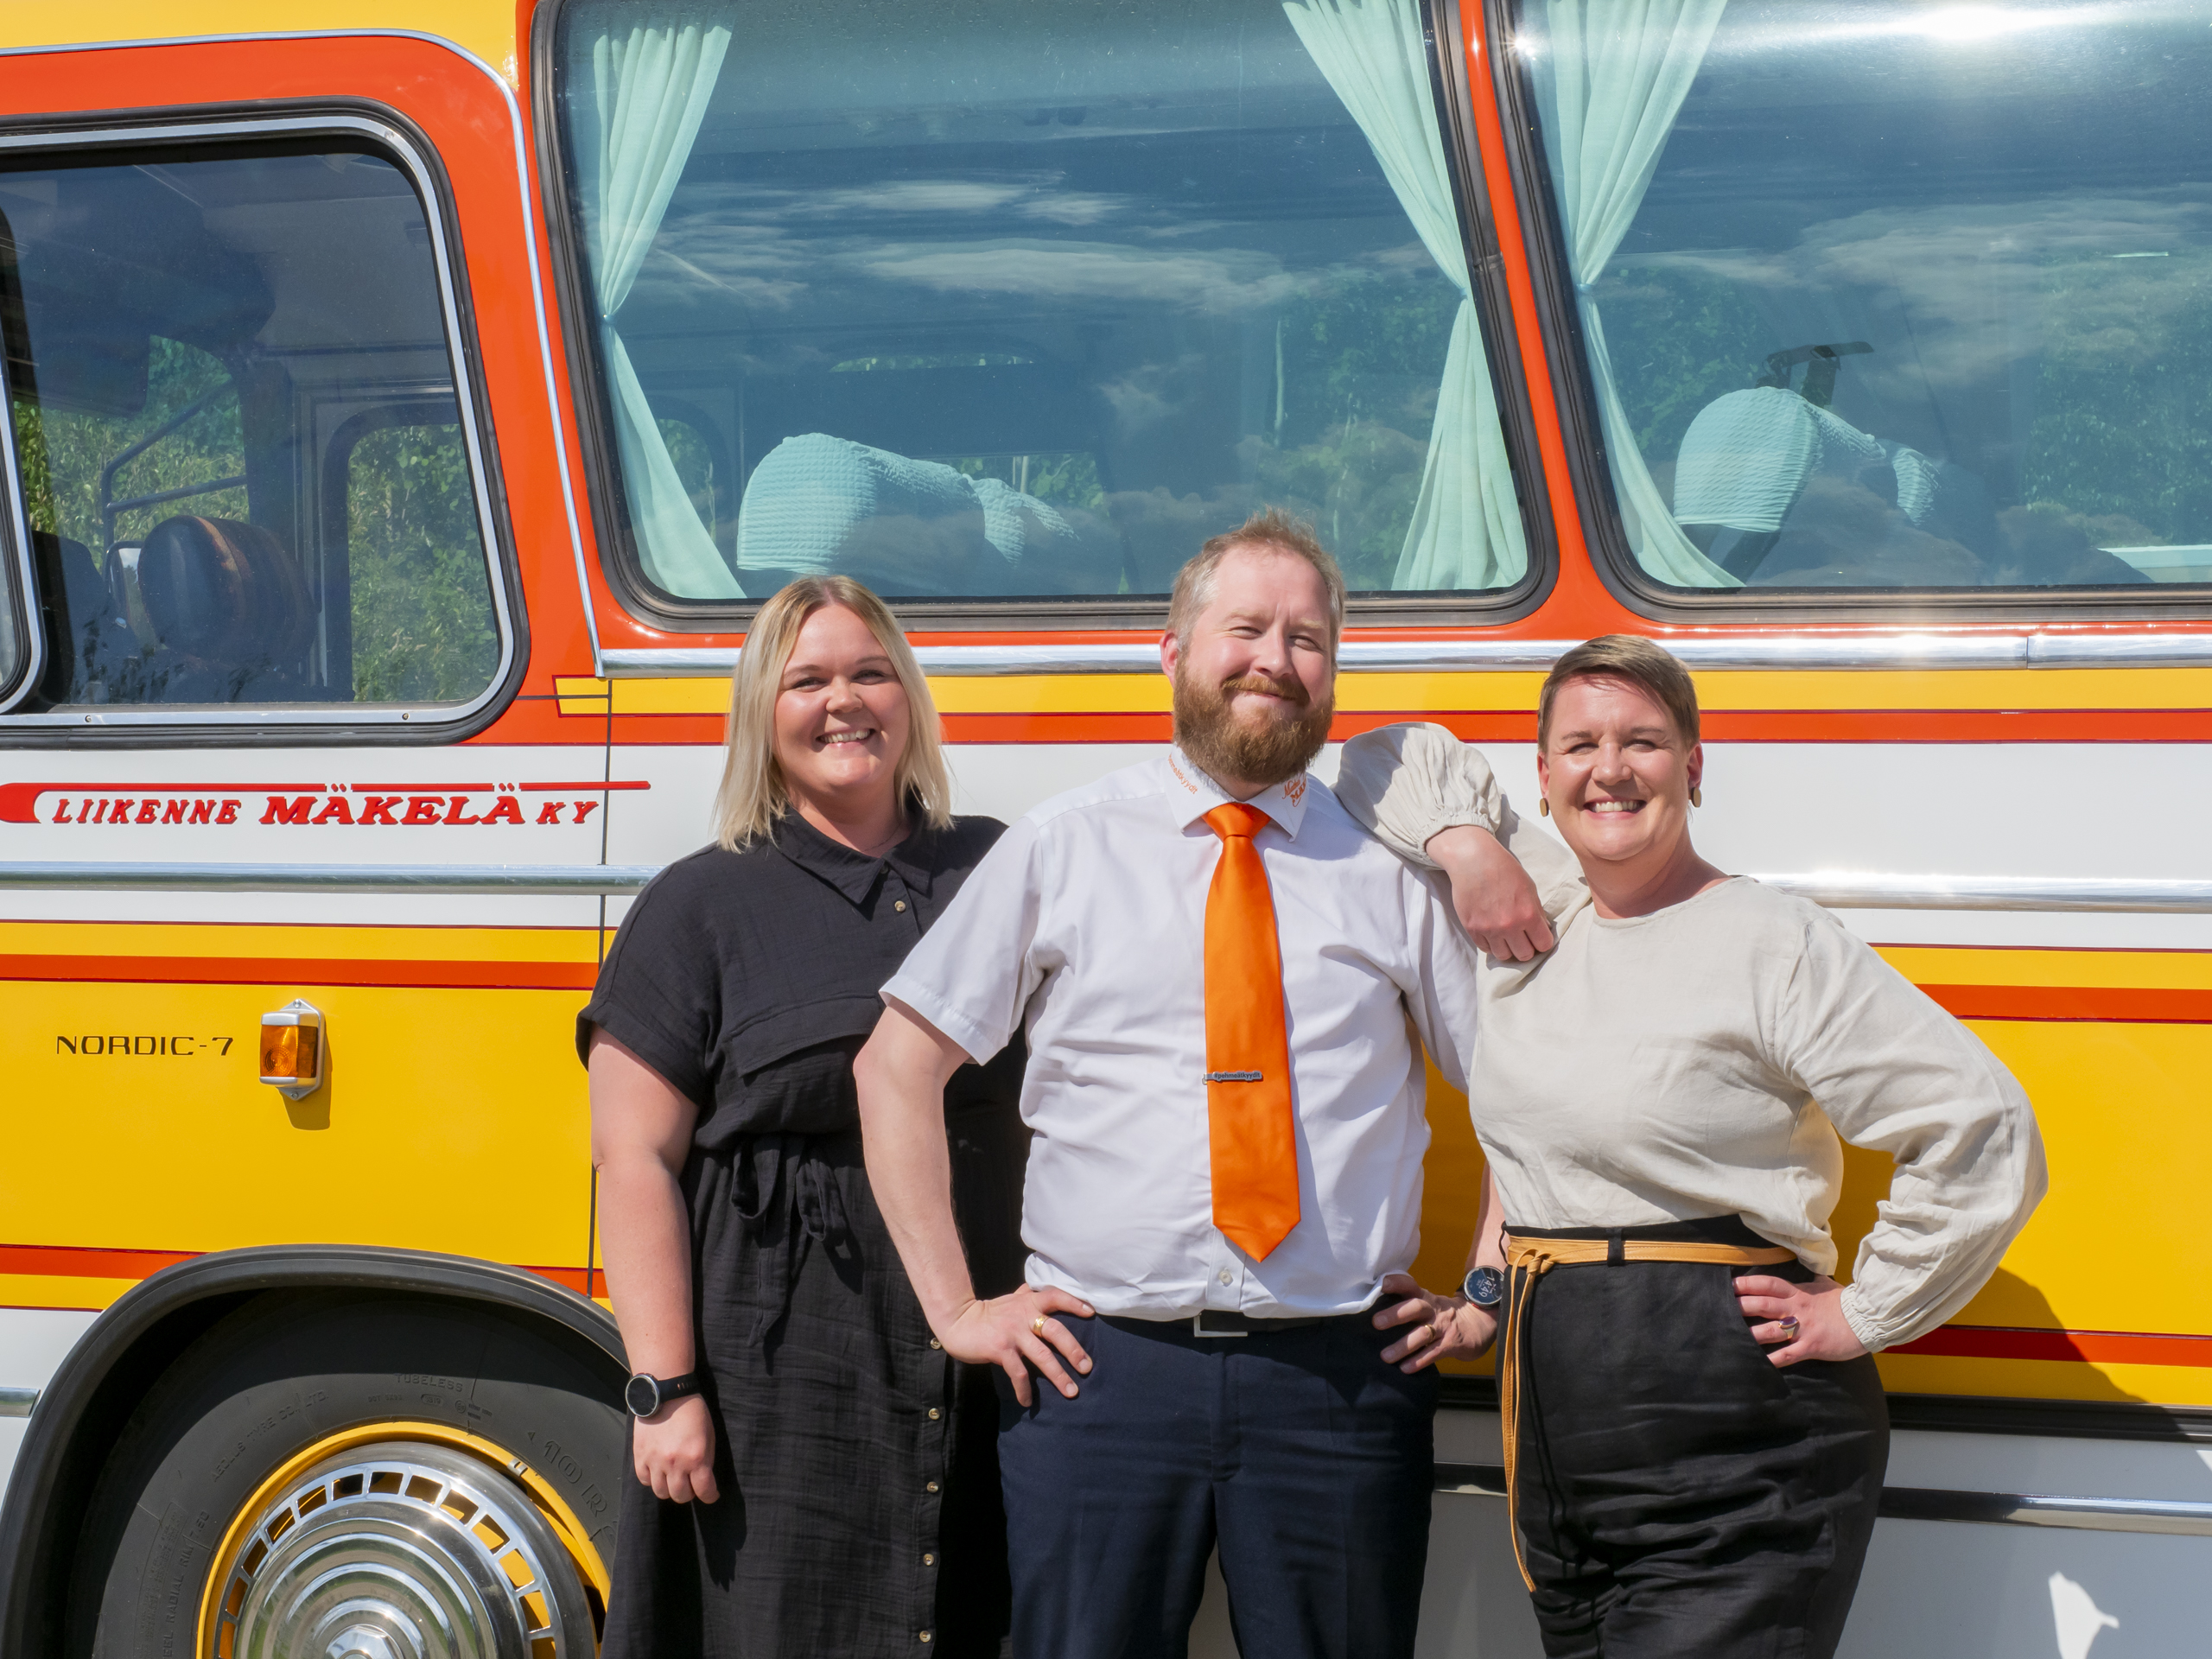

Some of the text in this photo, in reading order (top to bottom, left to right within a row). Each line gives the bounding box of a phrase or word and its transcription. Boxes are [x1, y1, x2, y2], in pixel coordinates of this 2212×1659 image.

[52, 783, 599, 824] LIIKENNE MÄKELÄ KY
[56, 1035, 234, 1056] NORDIC-7
[394, 1374, 464, 1392] TUBELESS
[246, 1416, 277, 1441] TYRE
[165, 1573, 185, 1624] RADIAL
[162, 1630, 174, 1659] EEL
